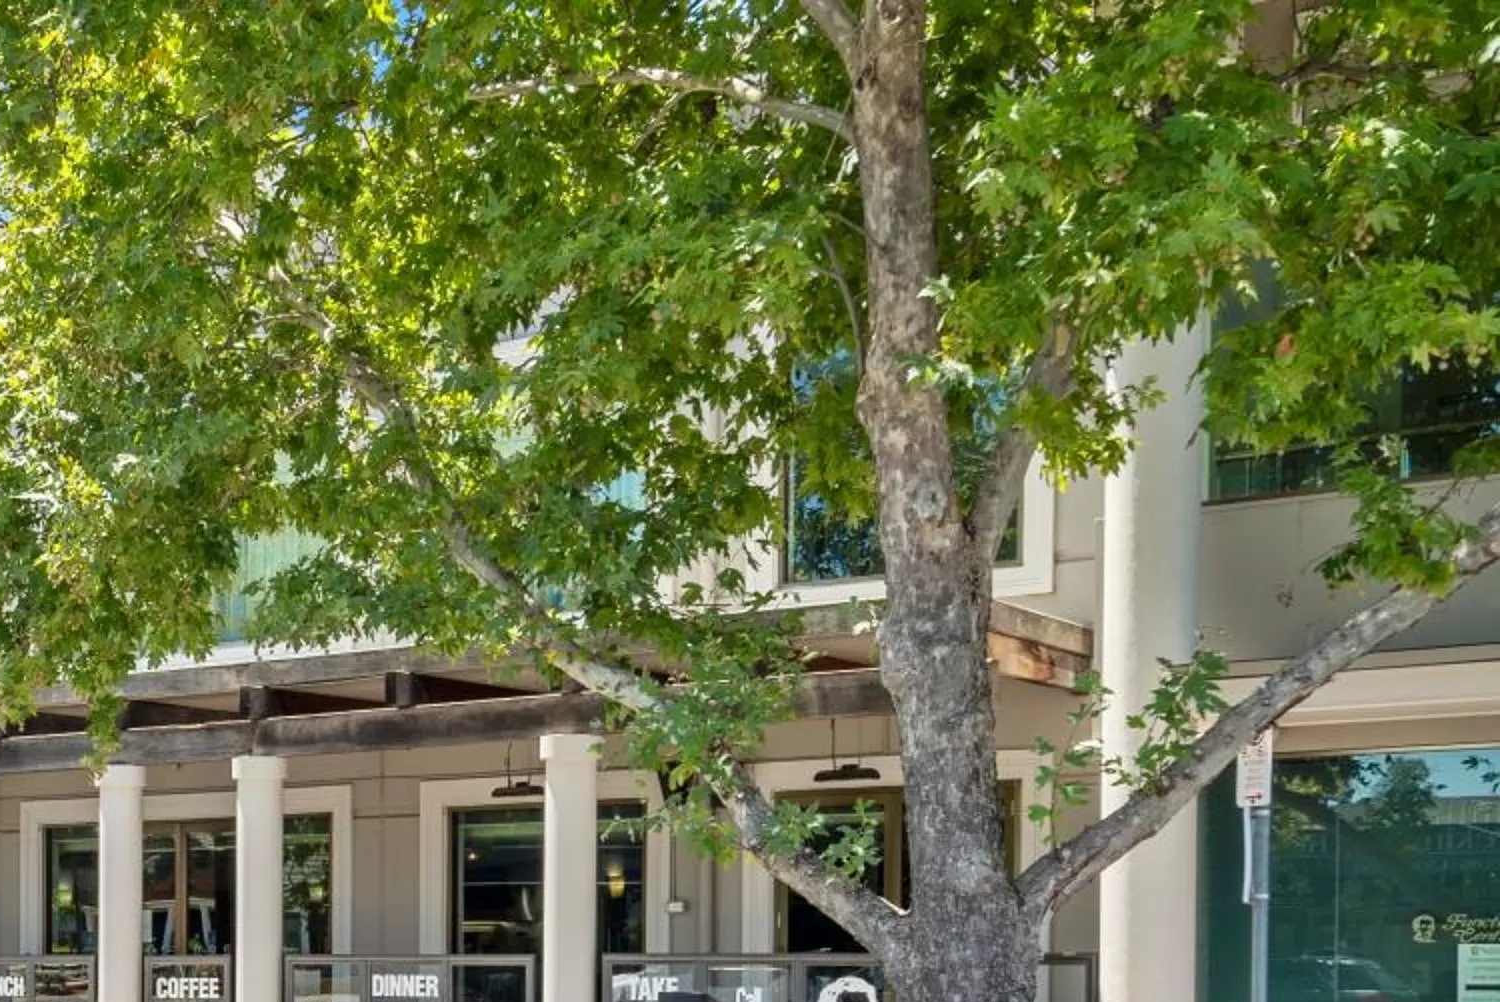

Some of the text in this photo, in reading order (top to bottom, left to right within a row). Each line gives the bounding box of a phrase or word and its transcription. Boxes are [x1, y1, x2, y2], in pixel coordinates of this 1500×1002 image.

[156, 976, 221, 999] COFFEE
[372, 974, 439, 998] DINNER
[630, 976, 679, 1001] TAKE
